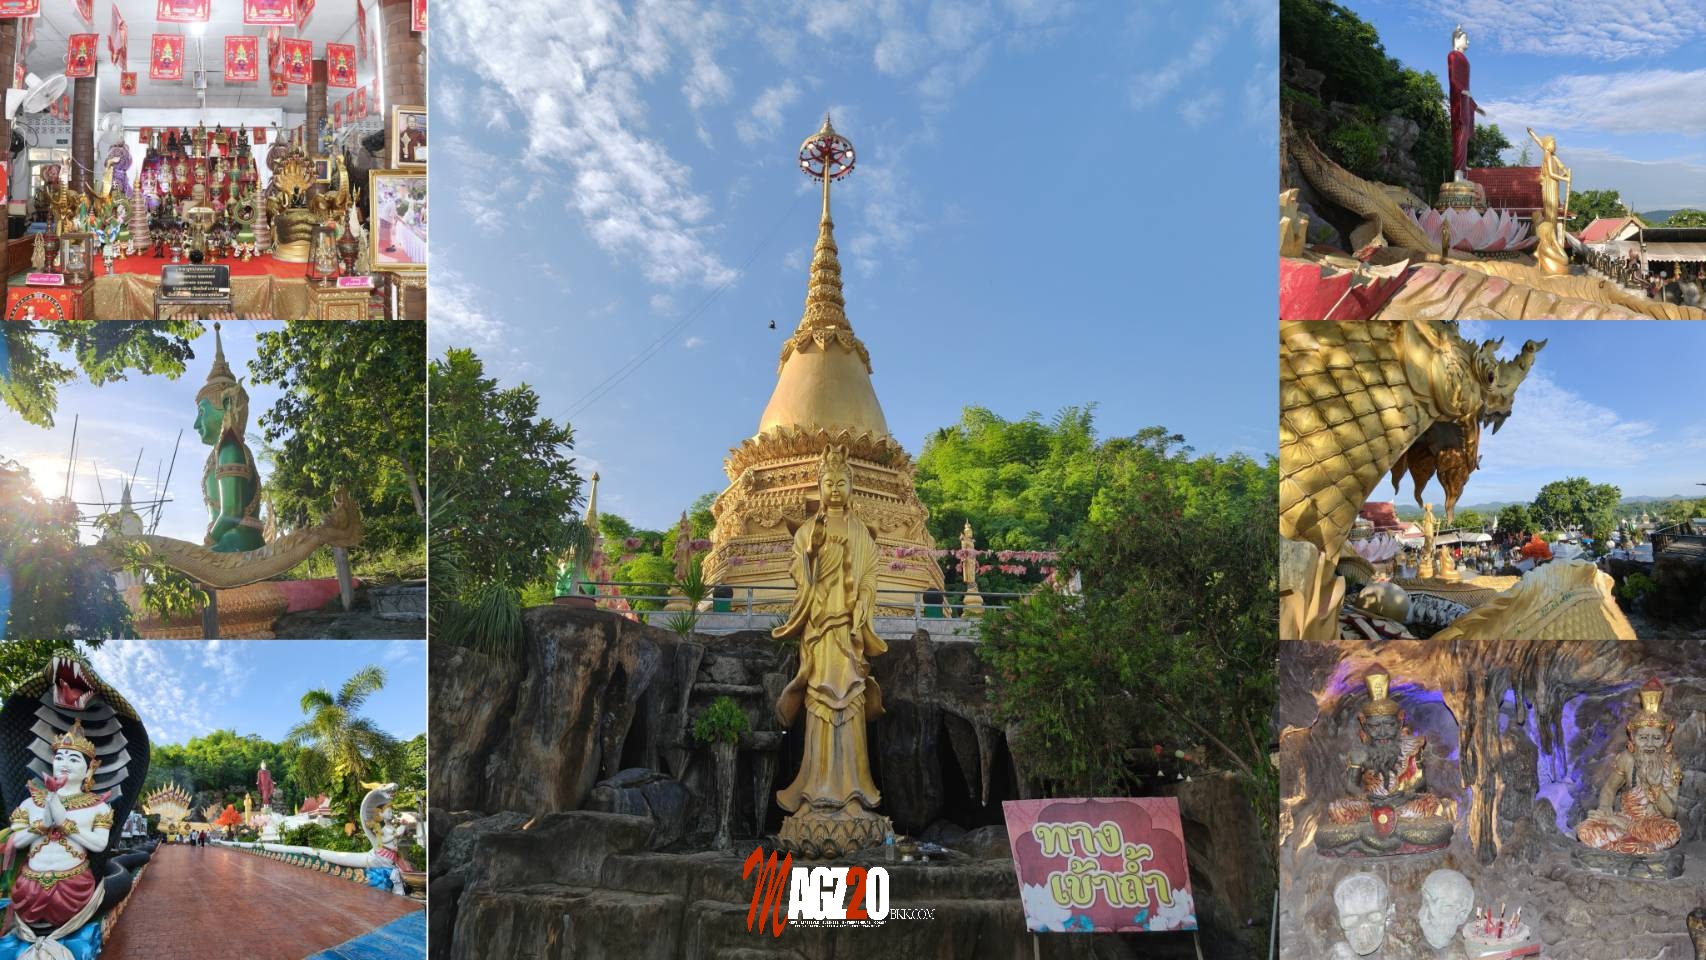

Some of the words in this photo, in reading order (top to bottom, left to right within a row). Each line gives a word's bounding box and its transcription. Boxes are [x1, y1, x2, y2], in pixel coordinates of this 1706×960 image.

[1033, 822, 1123, 856] ทาง
[1050, 844, 1174, 907] เข้าถ้ำ
